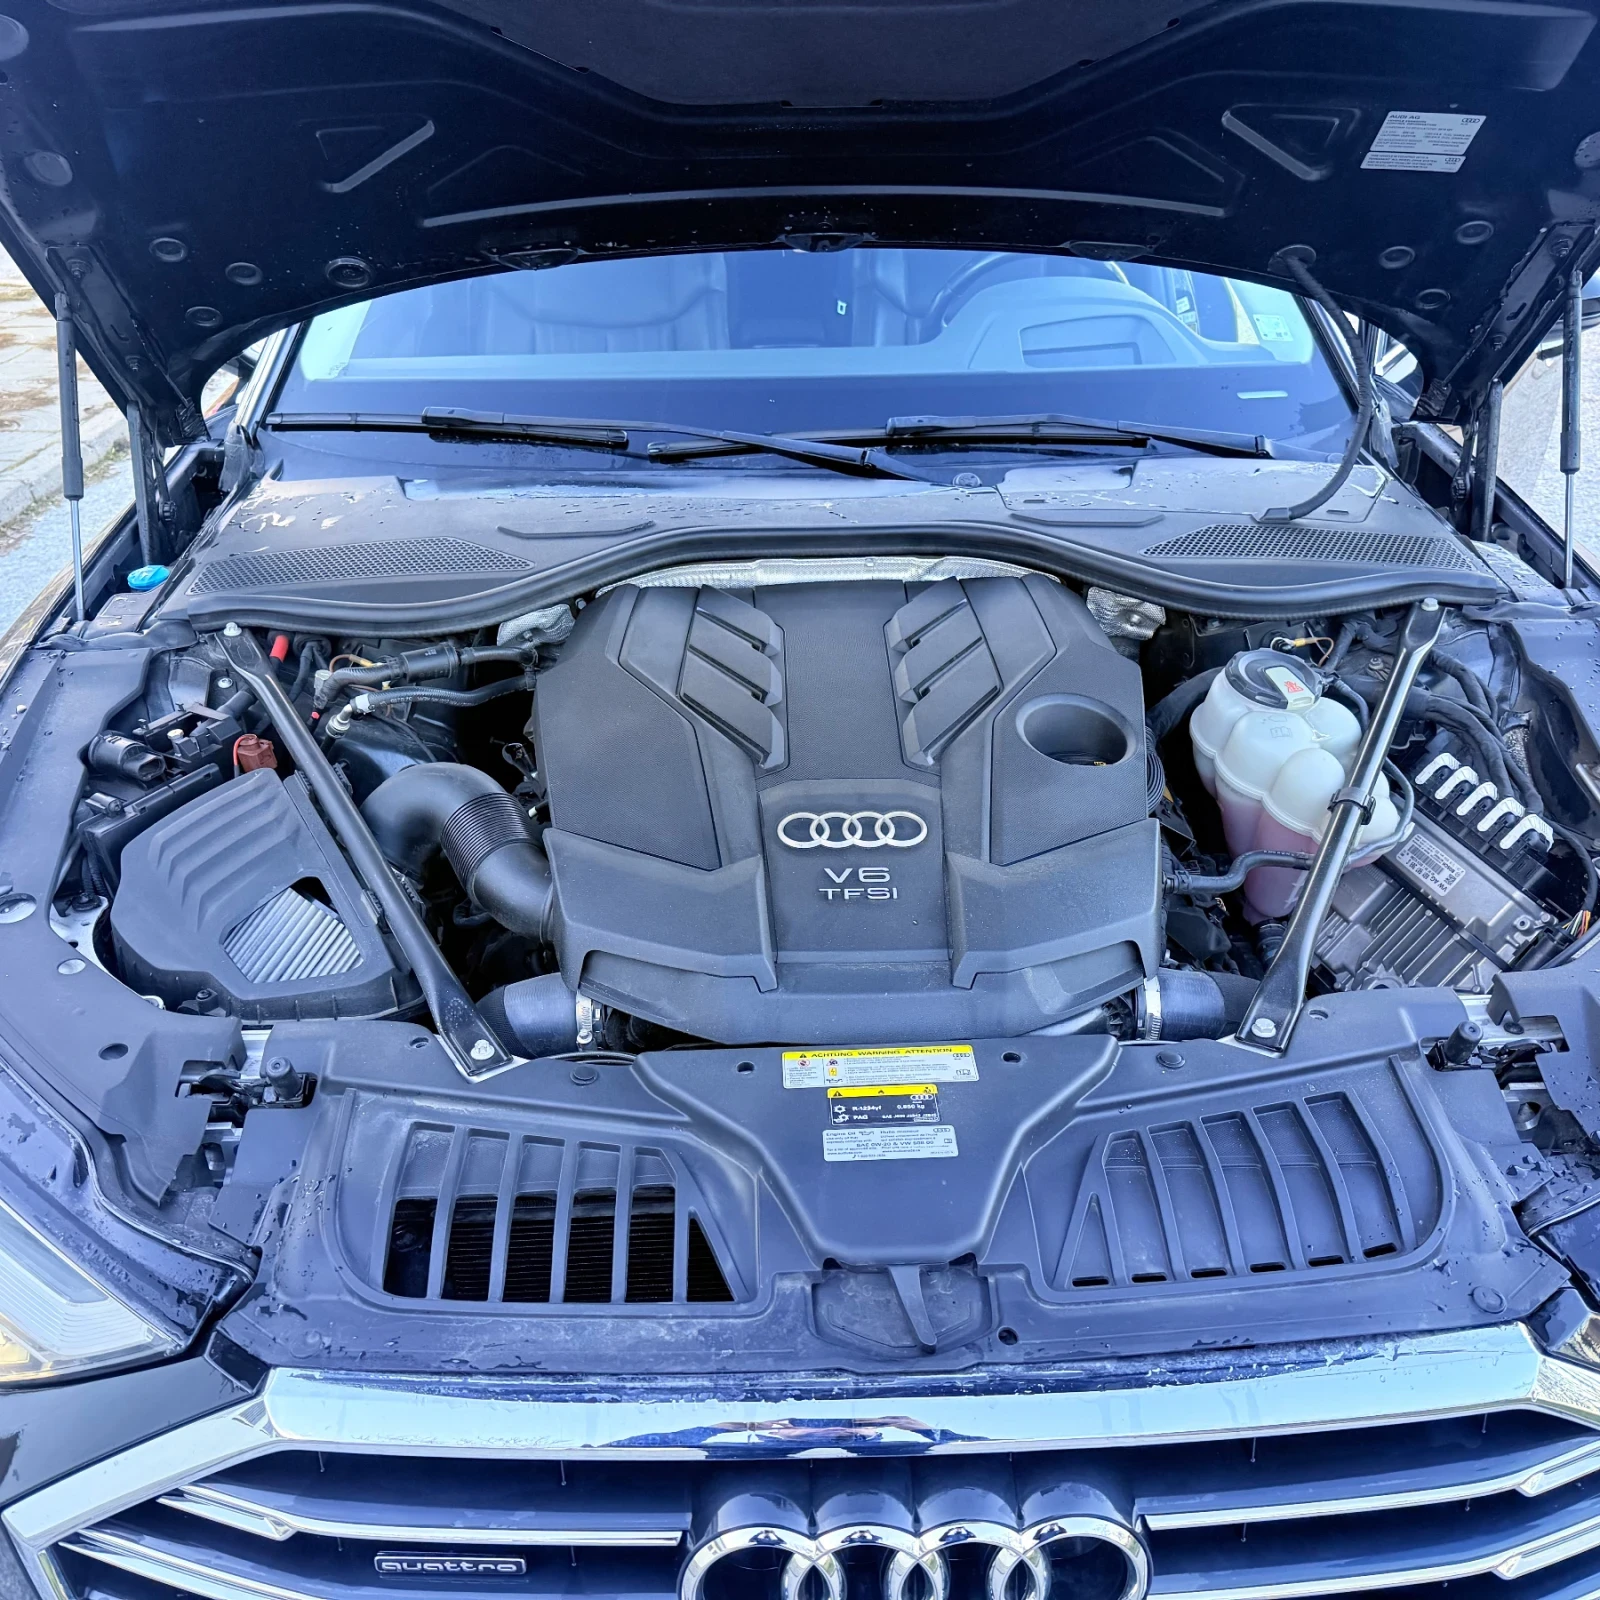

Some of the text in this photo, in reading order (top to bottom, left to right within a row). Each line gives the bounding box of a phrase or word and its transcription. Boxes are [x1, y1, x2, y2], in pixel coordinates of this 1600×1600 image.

[824, 867, 891, 883] V6
[818, 887, 898, 900] TFSI
[381, 1561, 517, 1572] quattro
